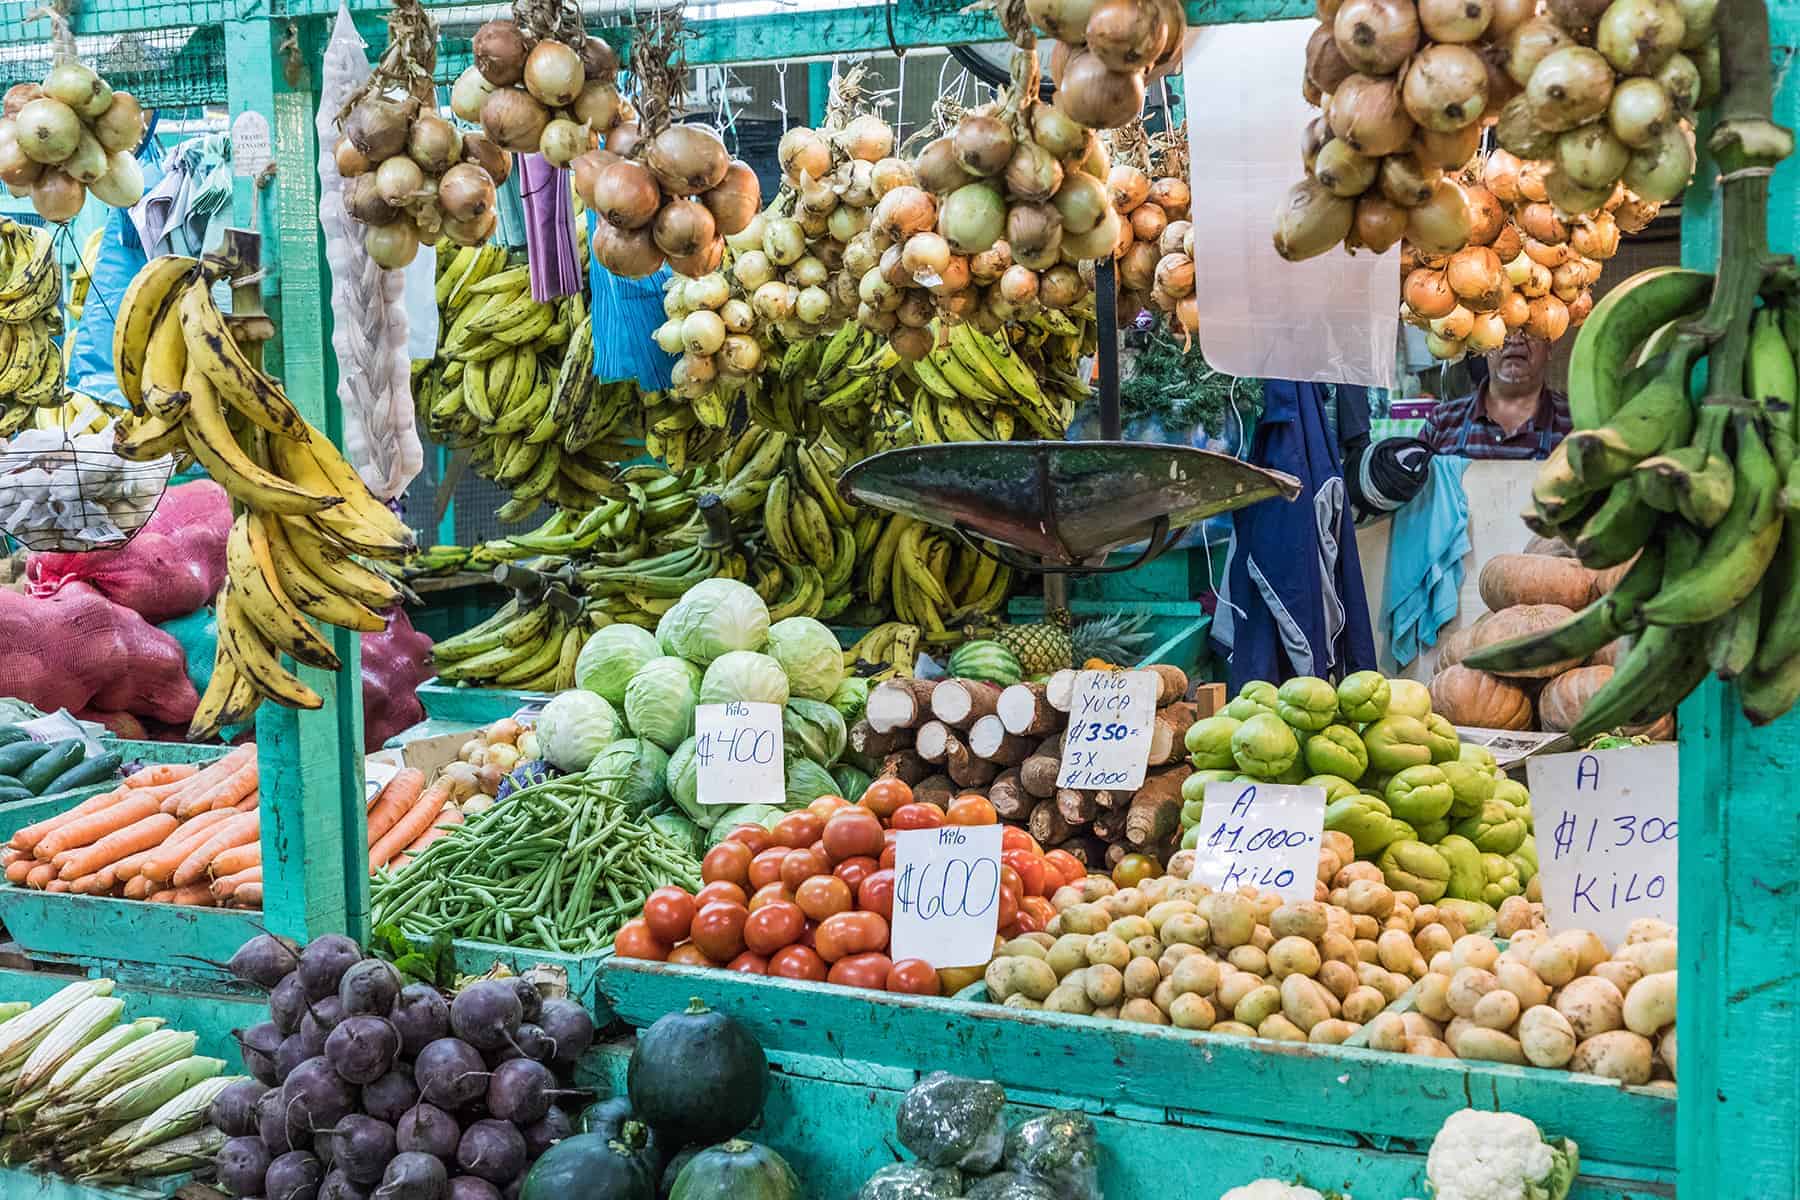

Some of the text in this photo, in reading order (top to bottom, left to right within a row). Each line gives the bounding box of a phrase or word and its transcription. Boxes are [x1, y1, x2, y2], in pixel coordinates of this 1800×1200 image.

[725, 701, 749, 716] Kilo
[1081, 693, 1131, 714] YUCA
[1577, 755, 1599, 791] A
[1231, 785, 1257, 818] A
[939, 828, 967, 846] Kilo
